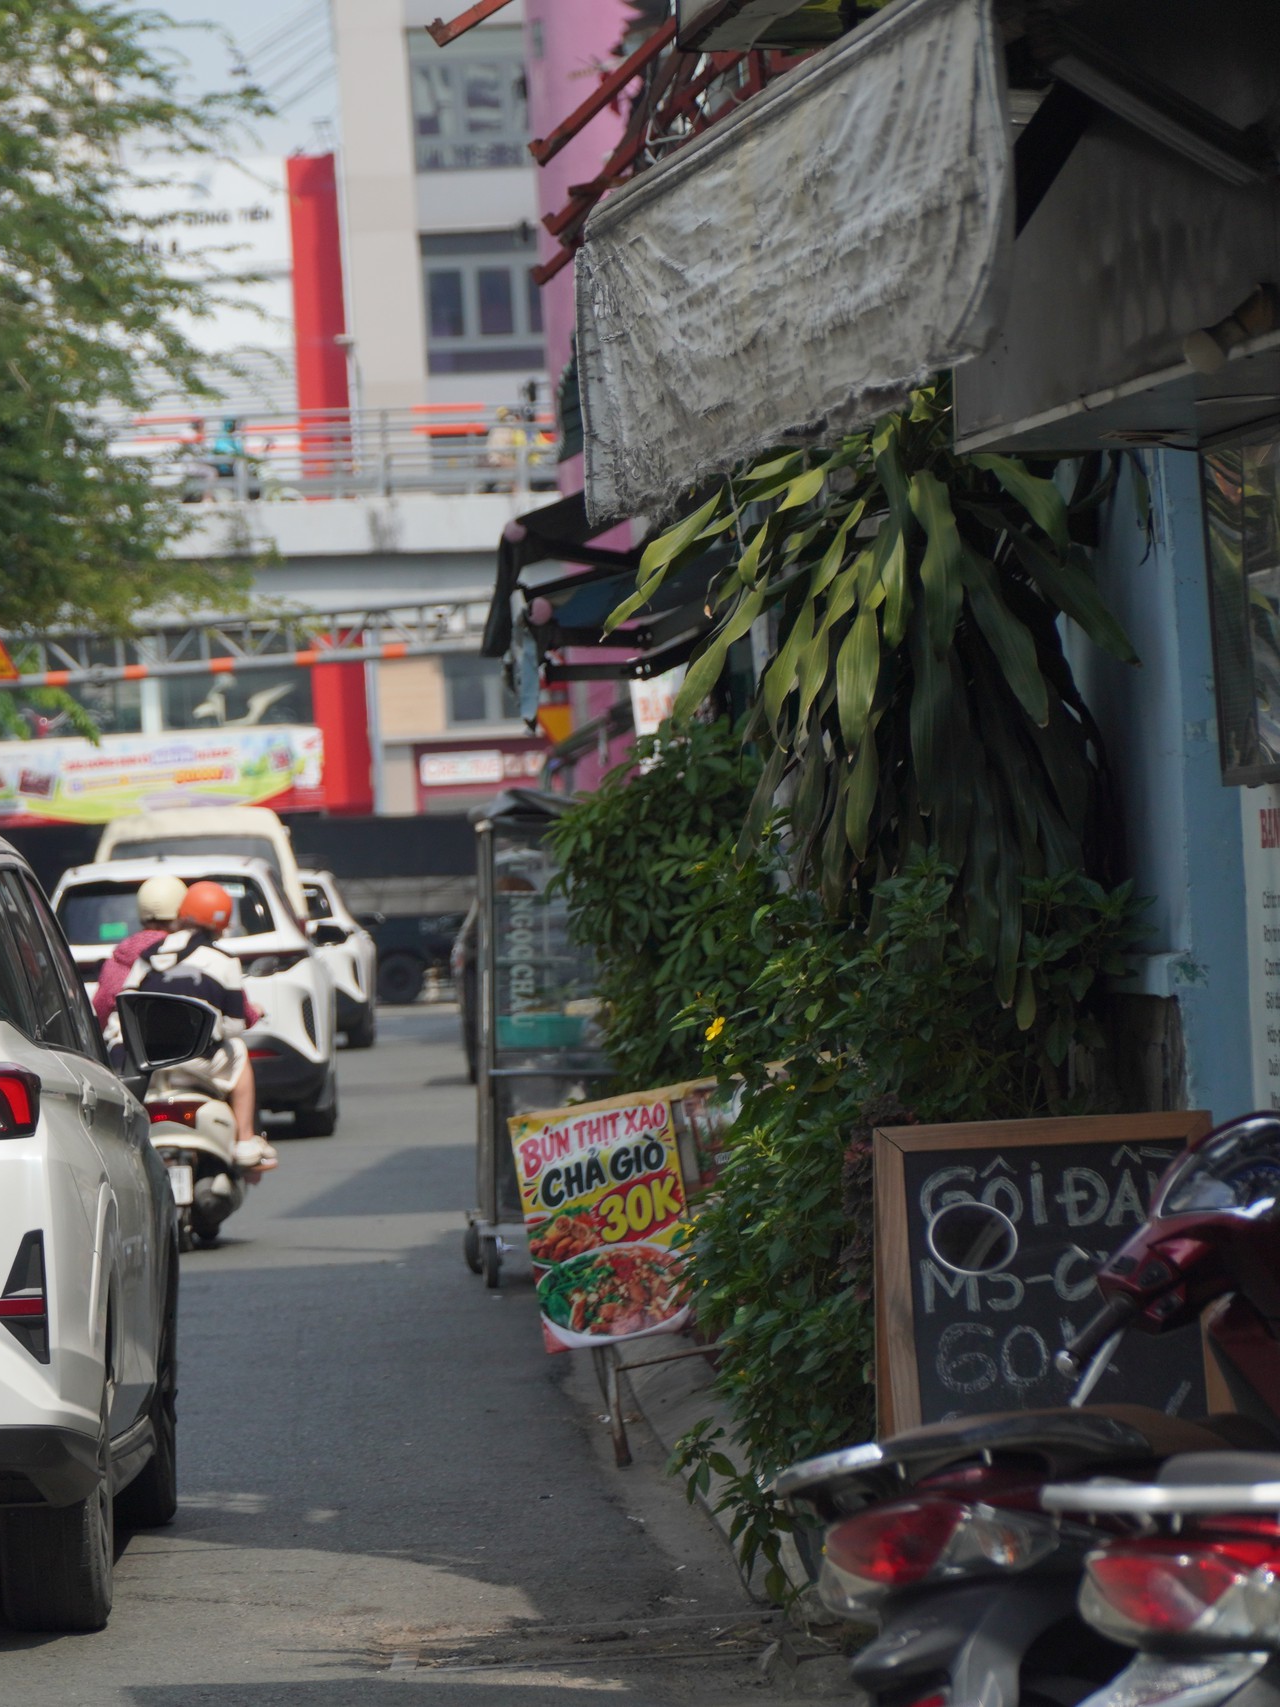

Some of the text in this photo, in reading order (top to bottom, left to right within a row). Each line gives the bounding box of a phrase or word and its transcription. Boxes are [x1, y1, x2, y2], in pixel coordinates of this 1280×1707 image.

[519, 1125, 570, 1180] BÚN
[573, 1110, 623, 1148] THỊT
[539, 1133, 666, 1209] CHẢ GIÒ
[598, 1174, 683, 1244] 30K
